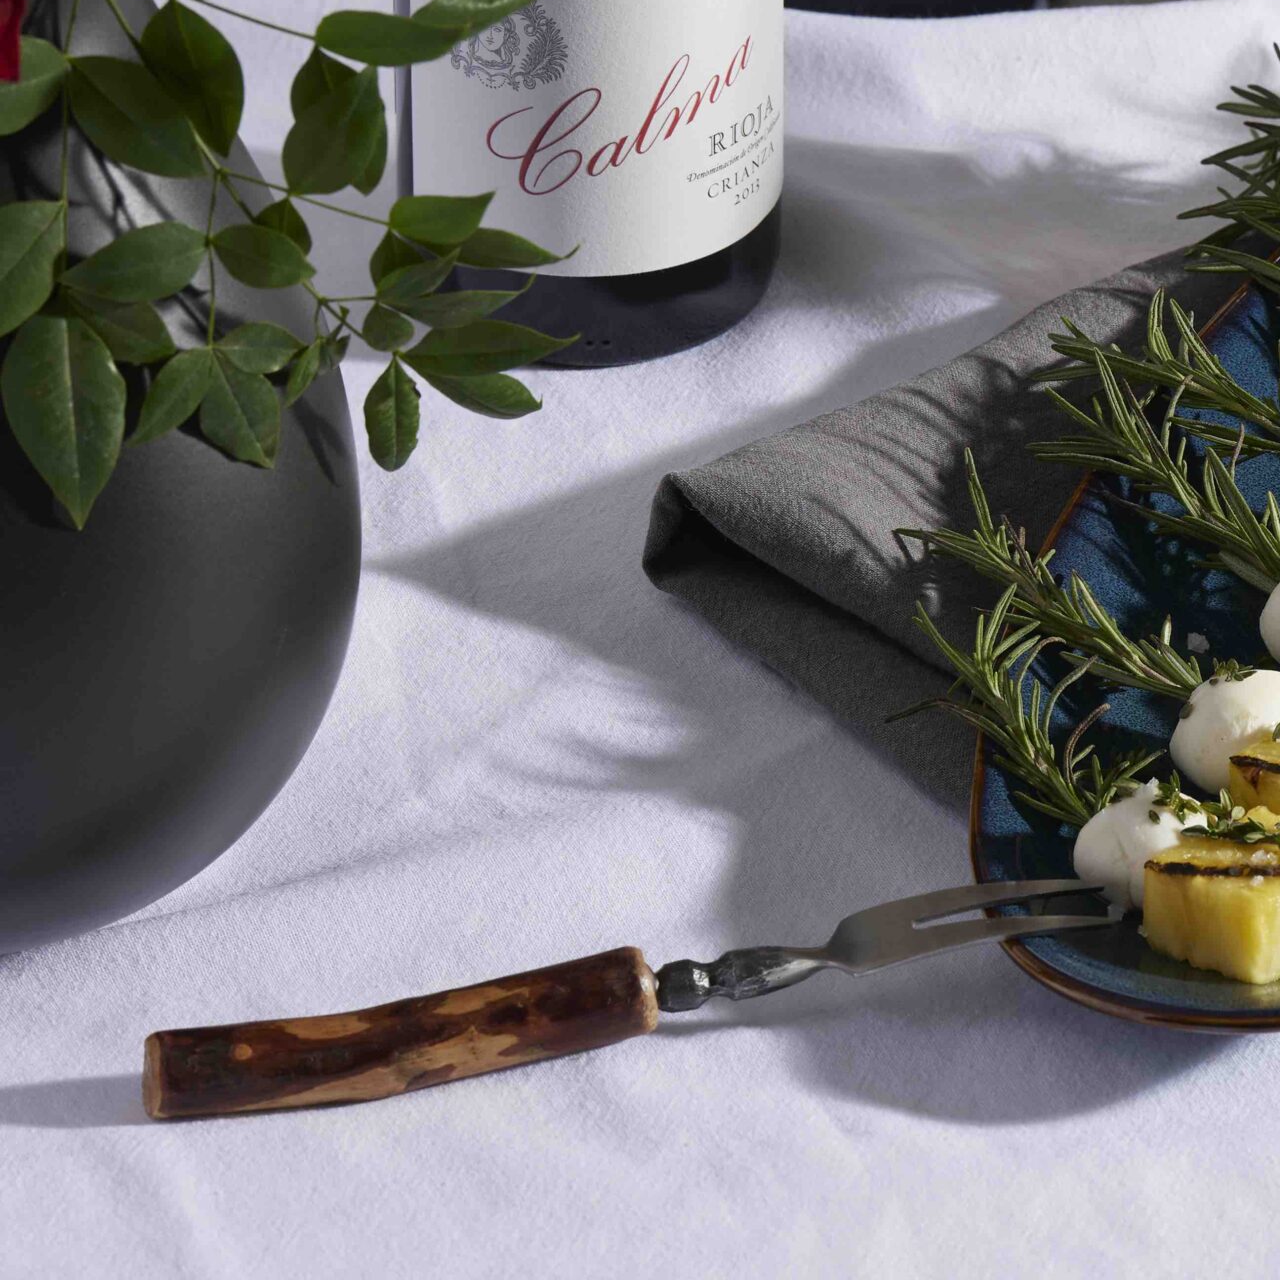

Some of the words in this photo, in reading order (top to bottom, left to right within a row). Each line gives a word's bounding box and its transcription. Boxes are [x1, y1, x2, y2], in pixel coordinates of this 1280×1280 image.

[486, 34, 754, 196] Calma
[708, 94, 774, 157] RIOJA
[707, 141, 775, 199] CRIANZA
